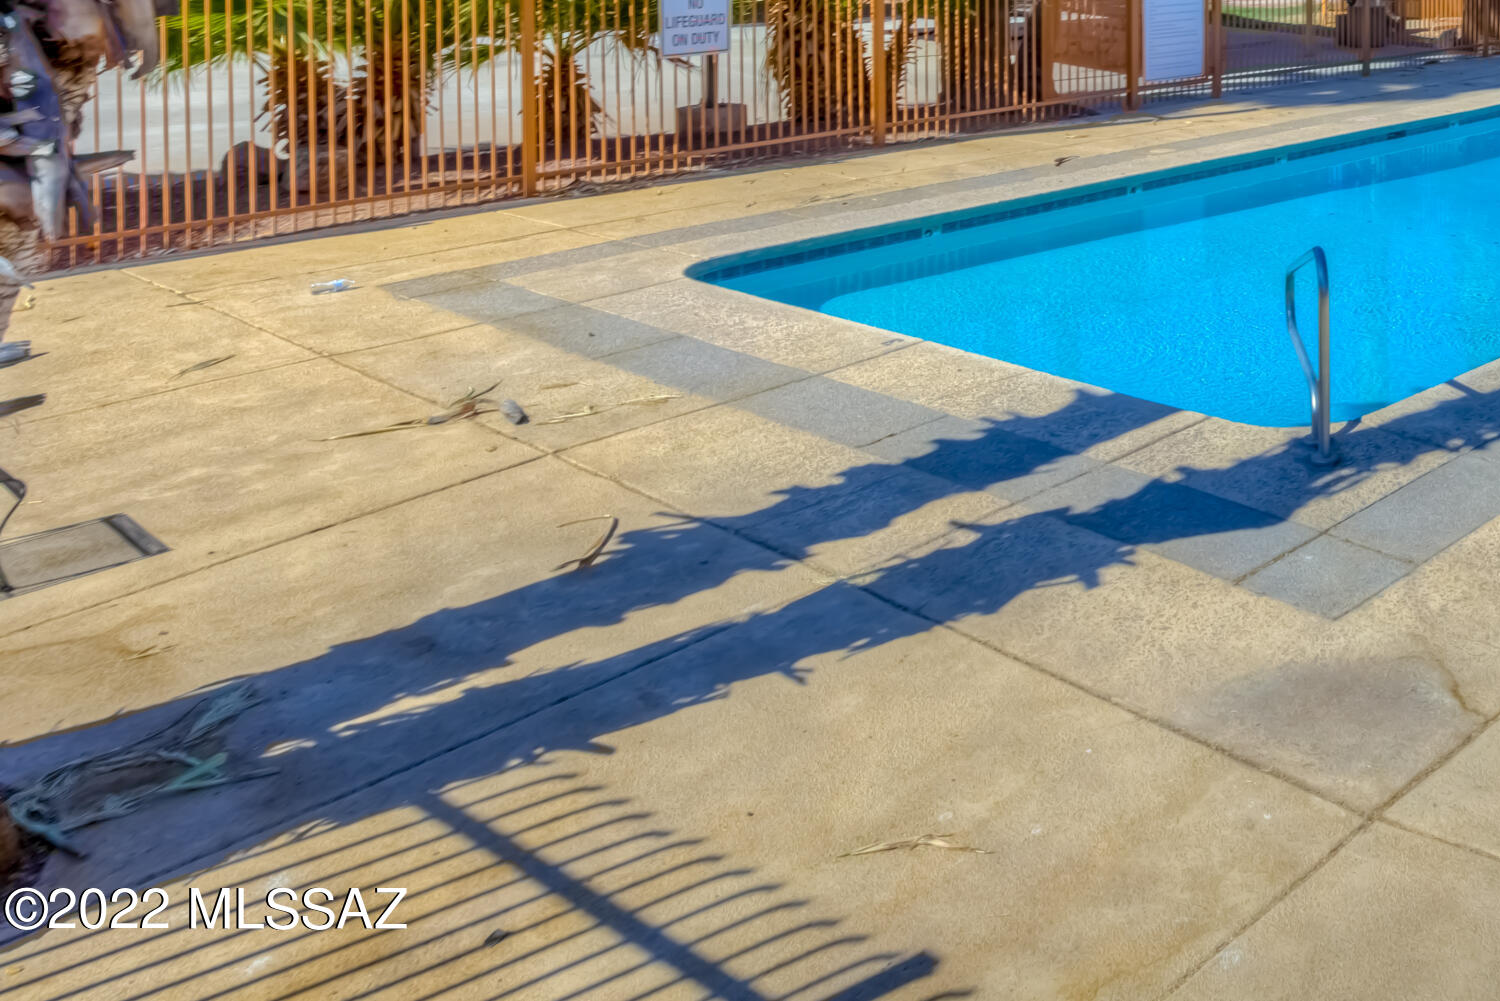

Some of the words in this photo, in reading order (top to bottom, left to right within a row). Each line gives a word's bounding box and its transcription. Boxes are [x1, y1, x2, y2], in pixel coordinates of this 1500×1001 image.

[664, 13, 726, 29] LIFEGUARD
[671, 33, 689, 47] ON
[690, 31, 721, 45] DUTY
